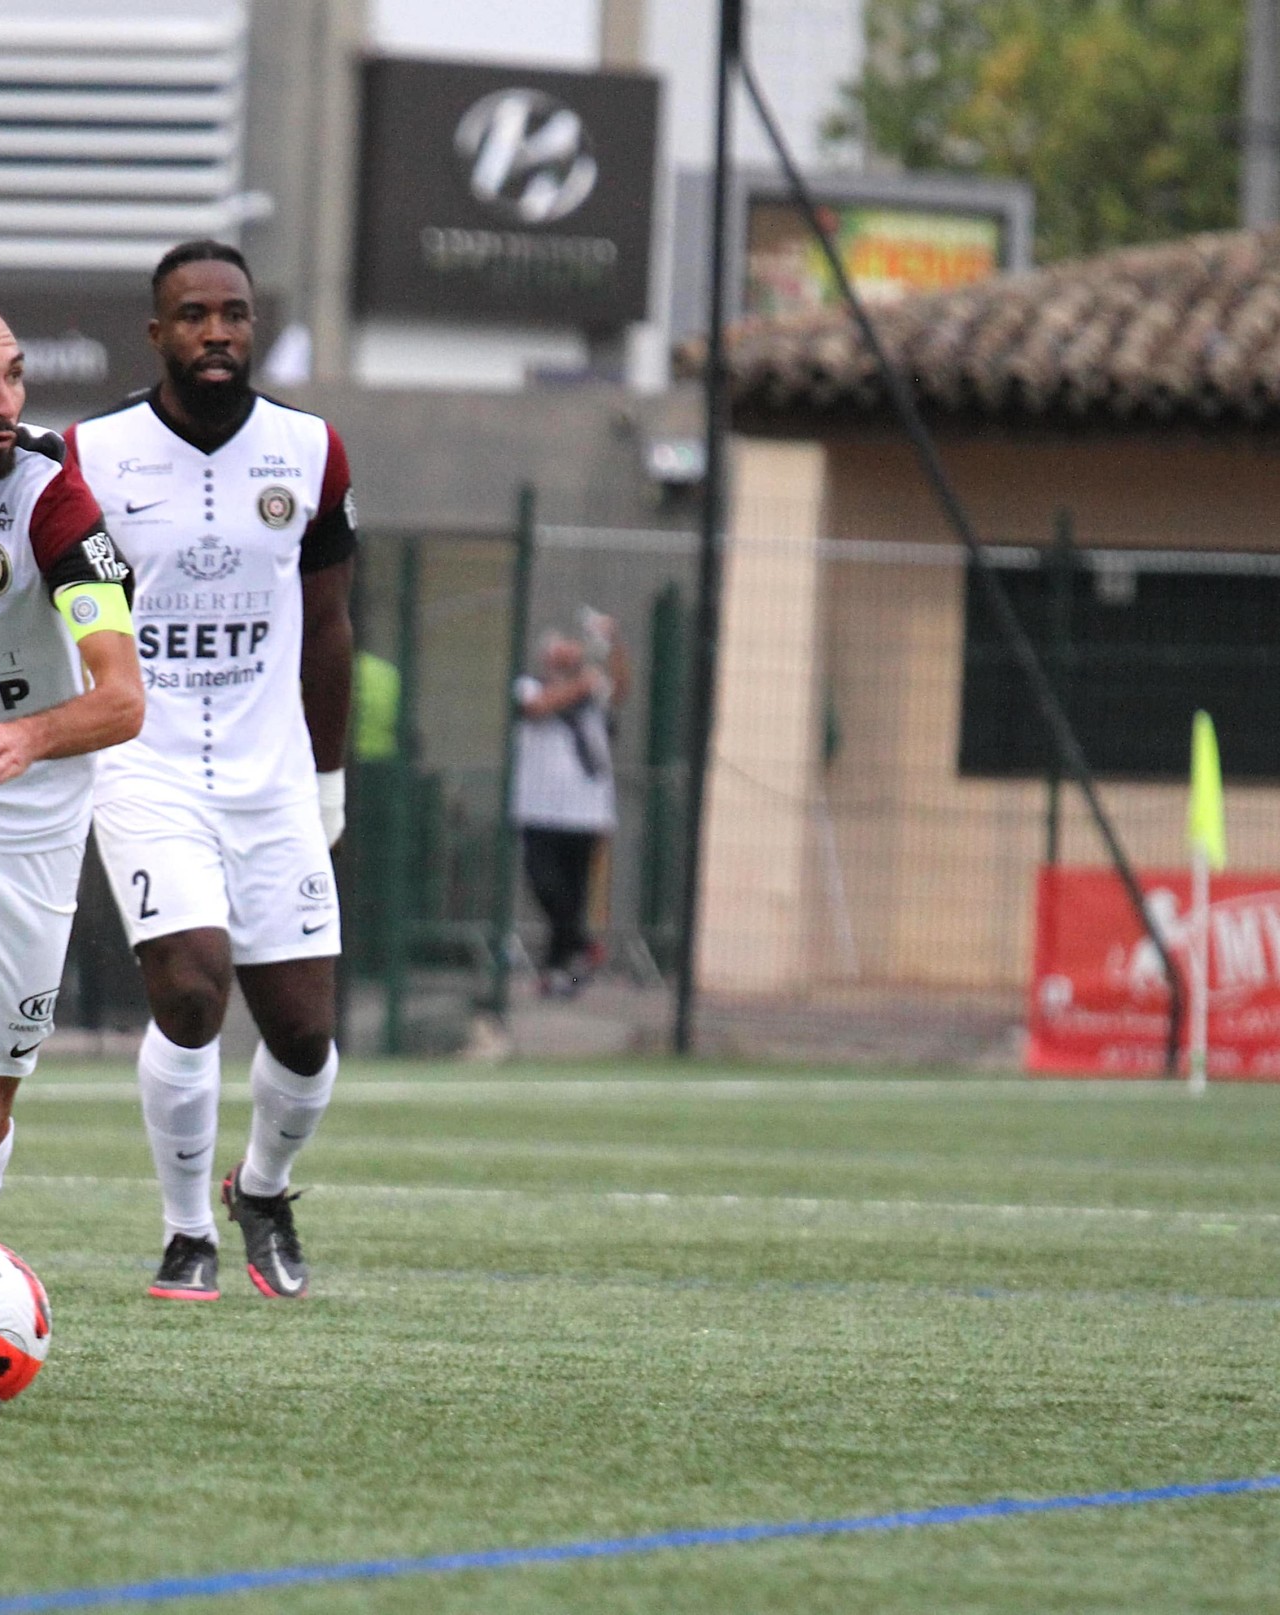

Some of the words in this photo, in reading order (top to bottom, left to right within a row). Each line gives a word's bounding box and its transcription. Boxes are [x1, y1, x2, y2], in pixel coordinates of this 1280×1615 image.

[249, 467, 302, 478] EXPERTS
[139, 589, 272, 611] ROBERTET
[138, 620, 269, 659] SEETP
[132, 868, 159, 919] 2
